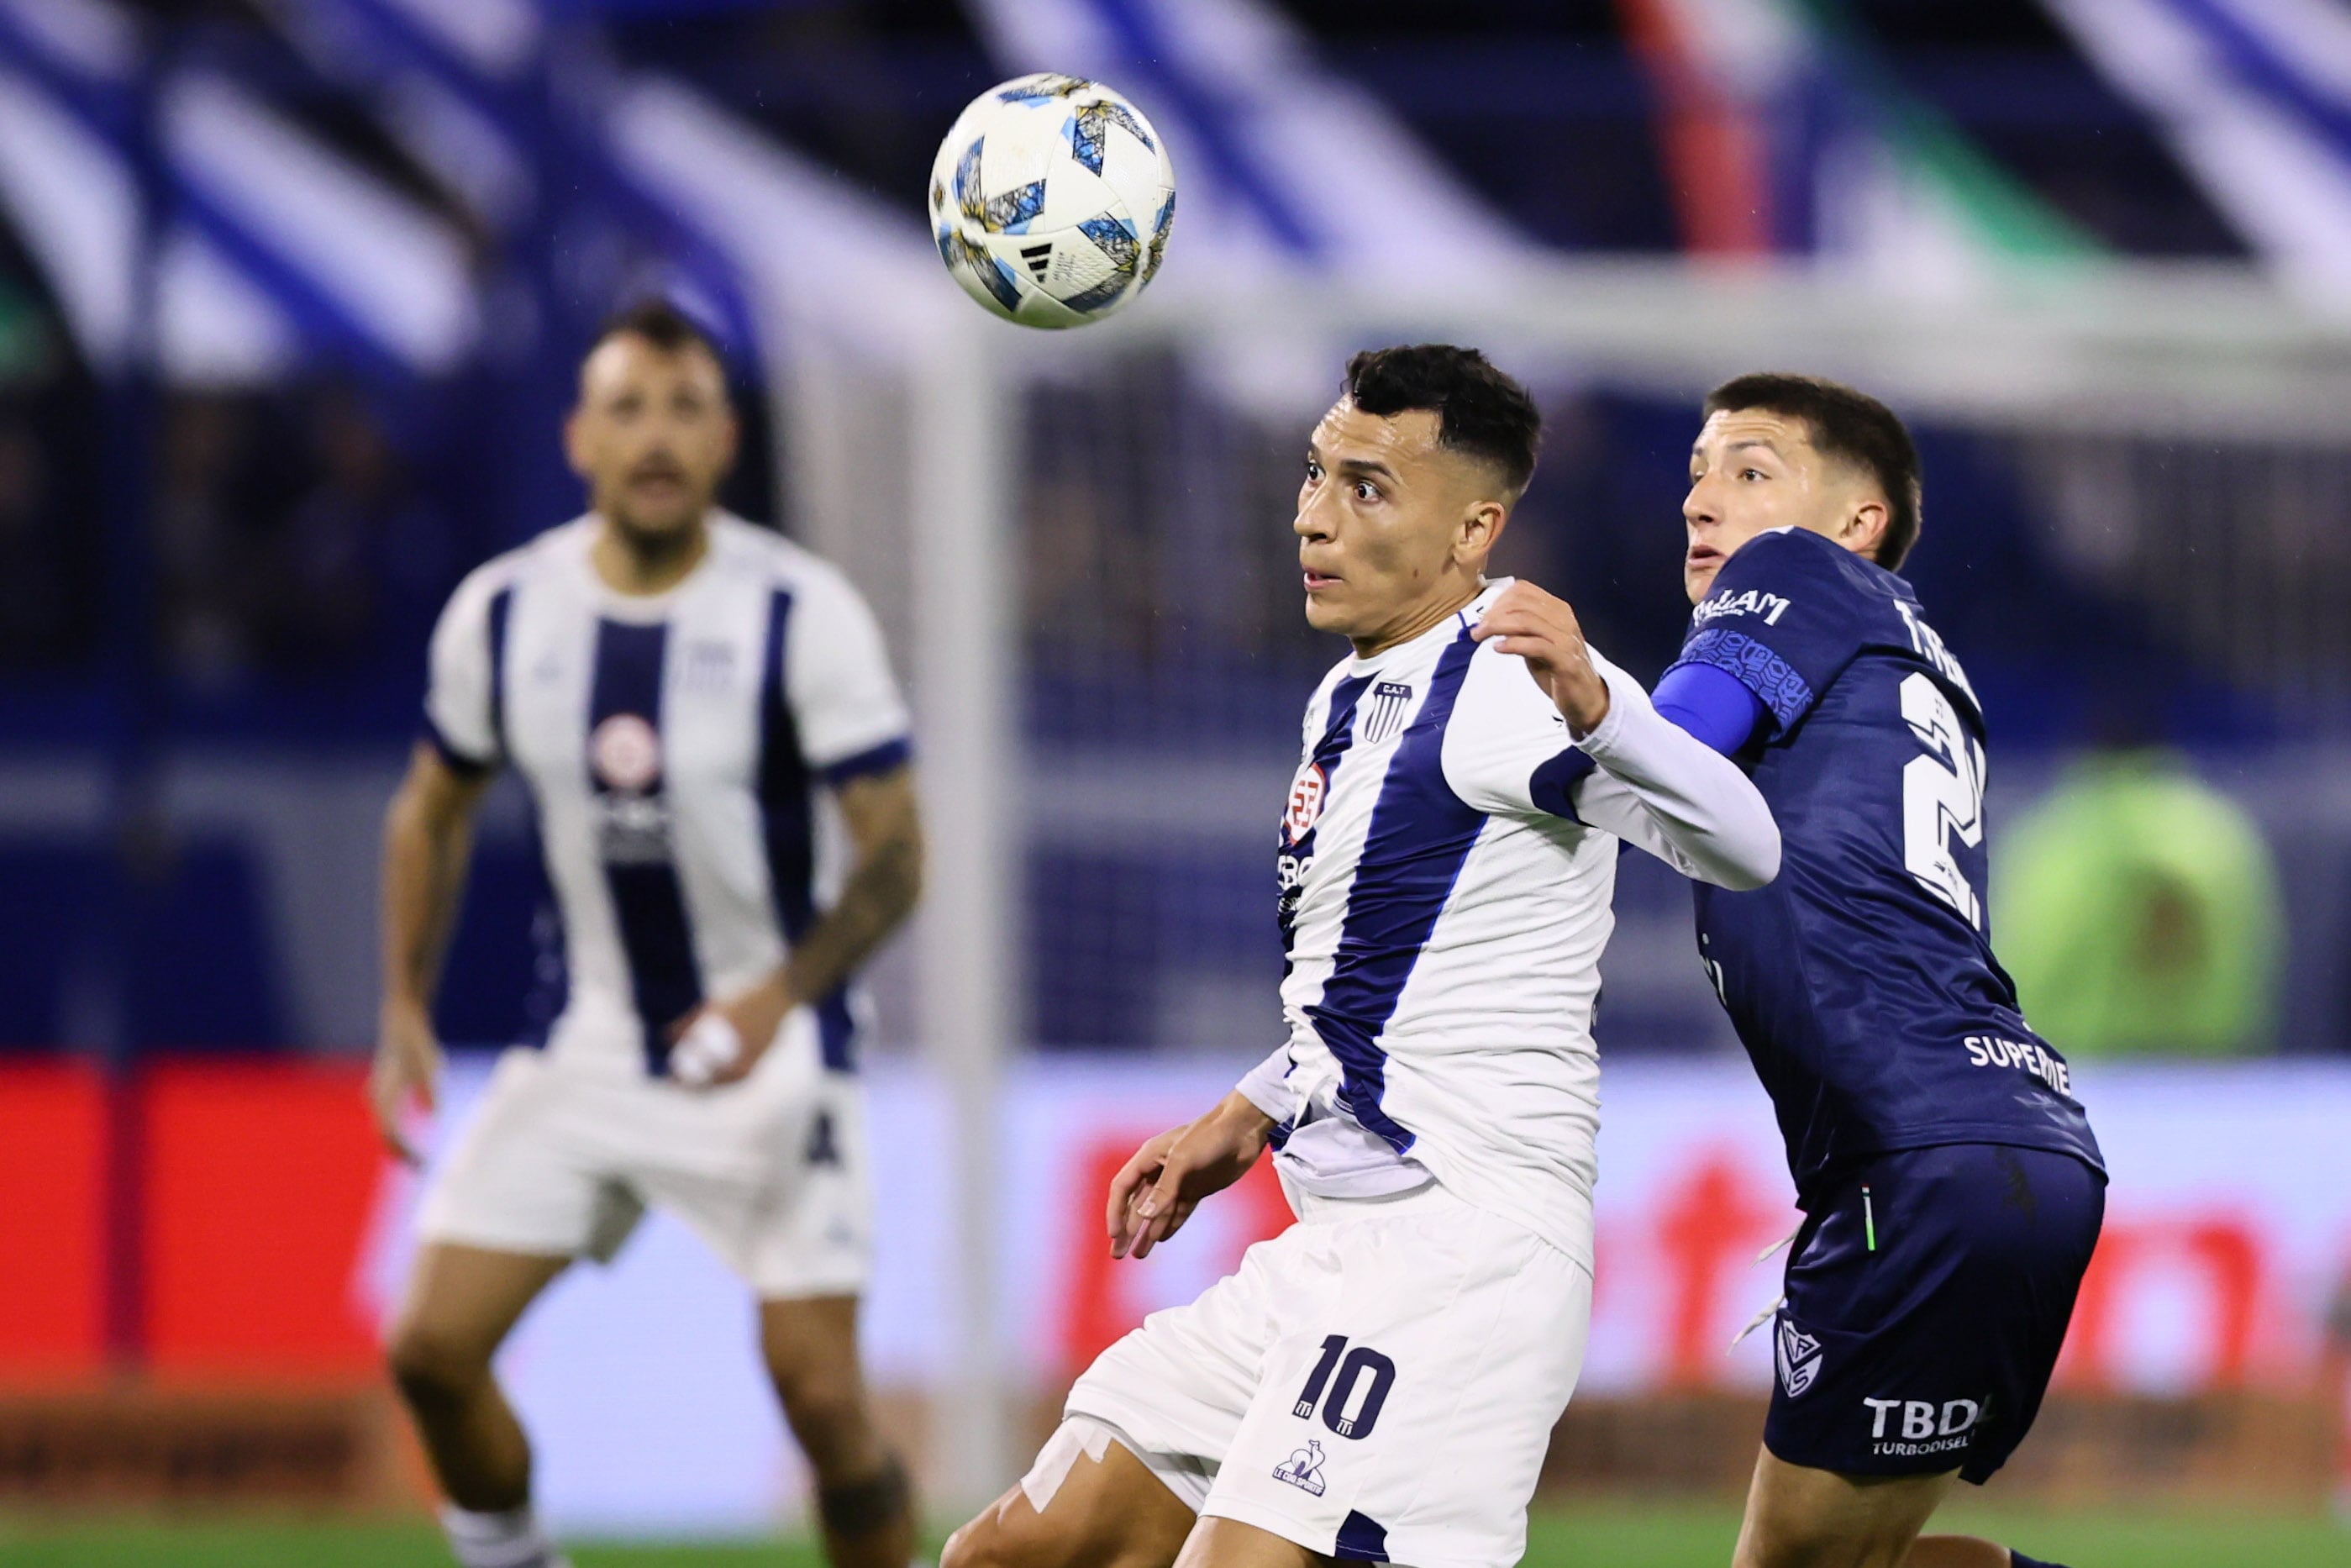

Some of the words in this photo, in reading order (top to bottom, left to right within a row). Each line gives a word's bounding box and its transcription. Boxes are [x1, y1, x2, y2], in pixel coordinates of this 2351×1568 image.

[1291, 1334, 1396, 1441] 10
[1872, 1435, 1970, 1456] TURBODISEL
[1274, 1468, 1284, 1478] LE
[1296, 1476, 1324, 1495] SPORTIF
